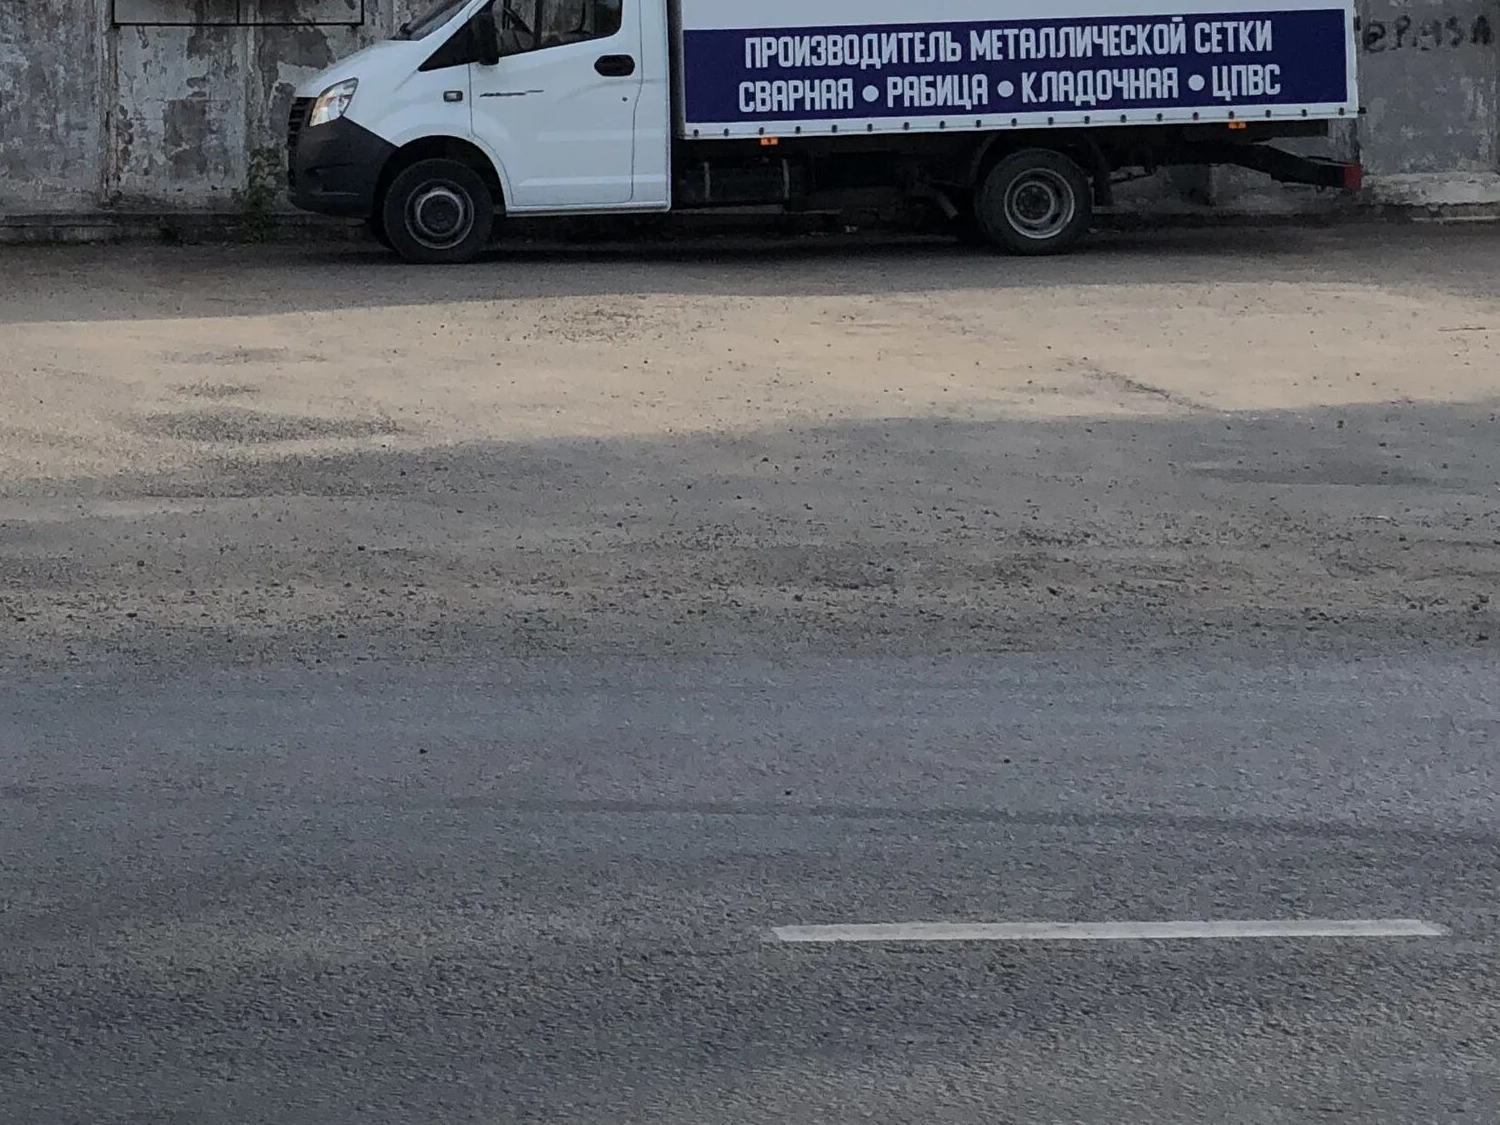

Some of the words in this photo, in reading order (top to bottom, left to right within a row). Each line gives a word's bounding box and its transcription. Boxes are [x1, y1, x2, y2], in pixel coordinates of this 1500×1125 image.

[745, 31, 962, 70] ПРОИЗВОДИТЕЛЬ
[970, 16, 1186, 62] МЕТАЛЛИЧЕСКОЙ
[1194, 20, 1272, 54] СЕТКИ
[739, 78, 854, 113] СВАРНАЯ
[887, 74, 988, 110] РАБИЦА
[1021, 67, 1179, 107] КЛАДОЧНАЯ
[1212, 64, 1281, 101] ЦПВС
